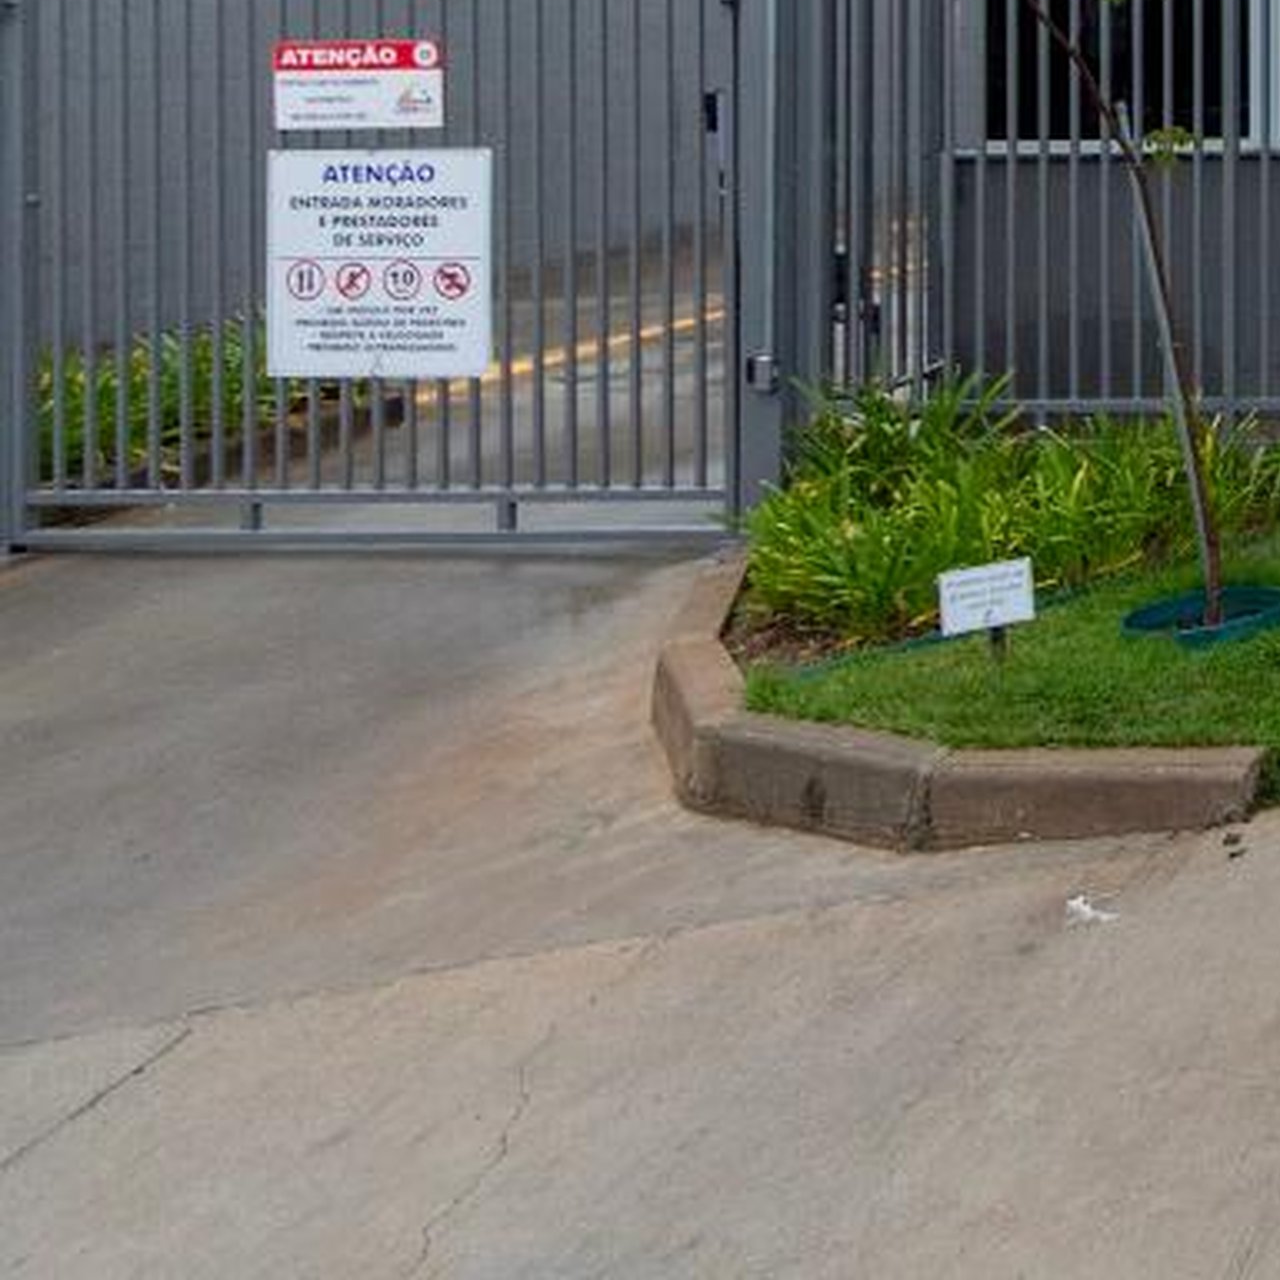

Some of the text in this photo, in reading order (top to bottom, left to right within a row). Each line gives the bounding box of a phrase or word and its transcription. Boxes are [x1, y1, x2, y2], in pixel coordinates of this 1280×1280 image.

[280, 45, 397, 67] ATENÇÃO
[321, 160, 436, 186] ATENÇÃO
[289, 196, 468, 209] ENTRADA MORADORES
[318, 215, 439, 228] E PRESTADORES
[332, 233, 425, 249] DE SERVIÇO
